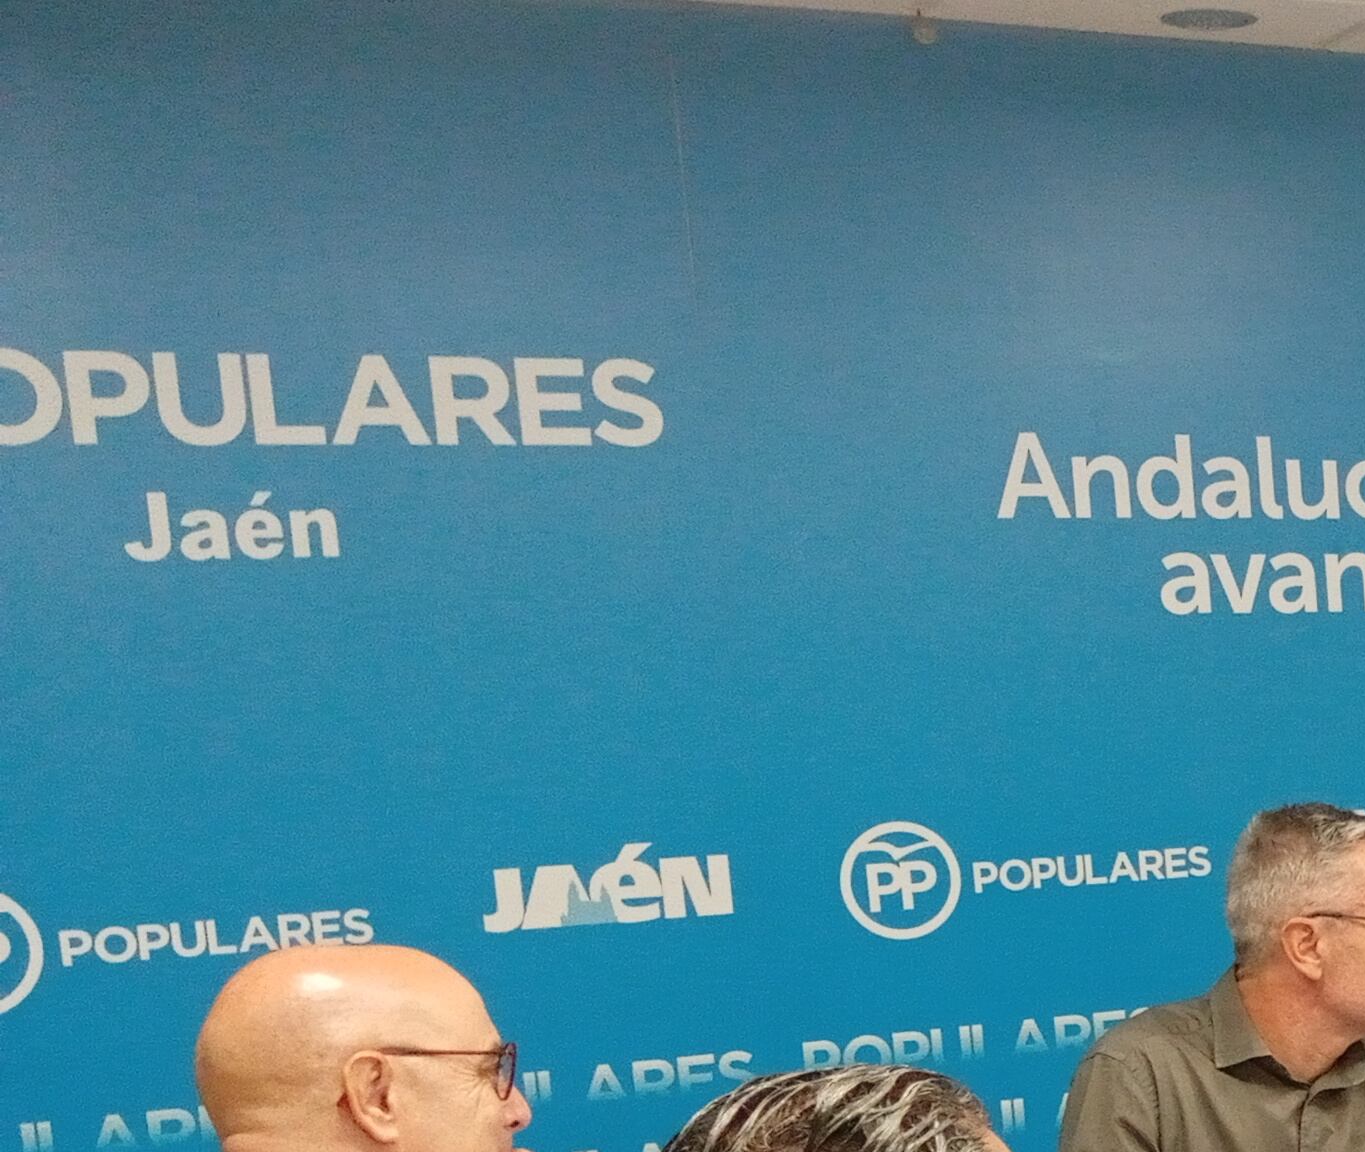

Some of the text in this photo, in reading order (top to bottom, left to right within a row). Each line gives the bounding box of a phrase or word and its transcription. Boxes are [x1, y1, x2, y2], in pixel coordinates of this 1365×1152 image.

[124, 491, 341, 562] Jaén
[972, 845, 1213, 894] POPULARES
[58, 907, 375, 967] POPULARES
